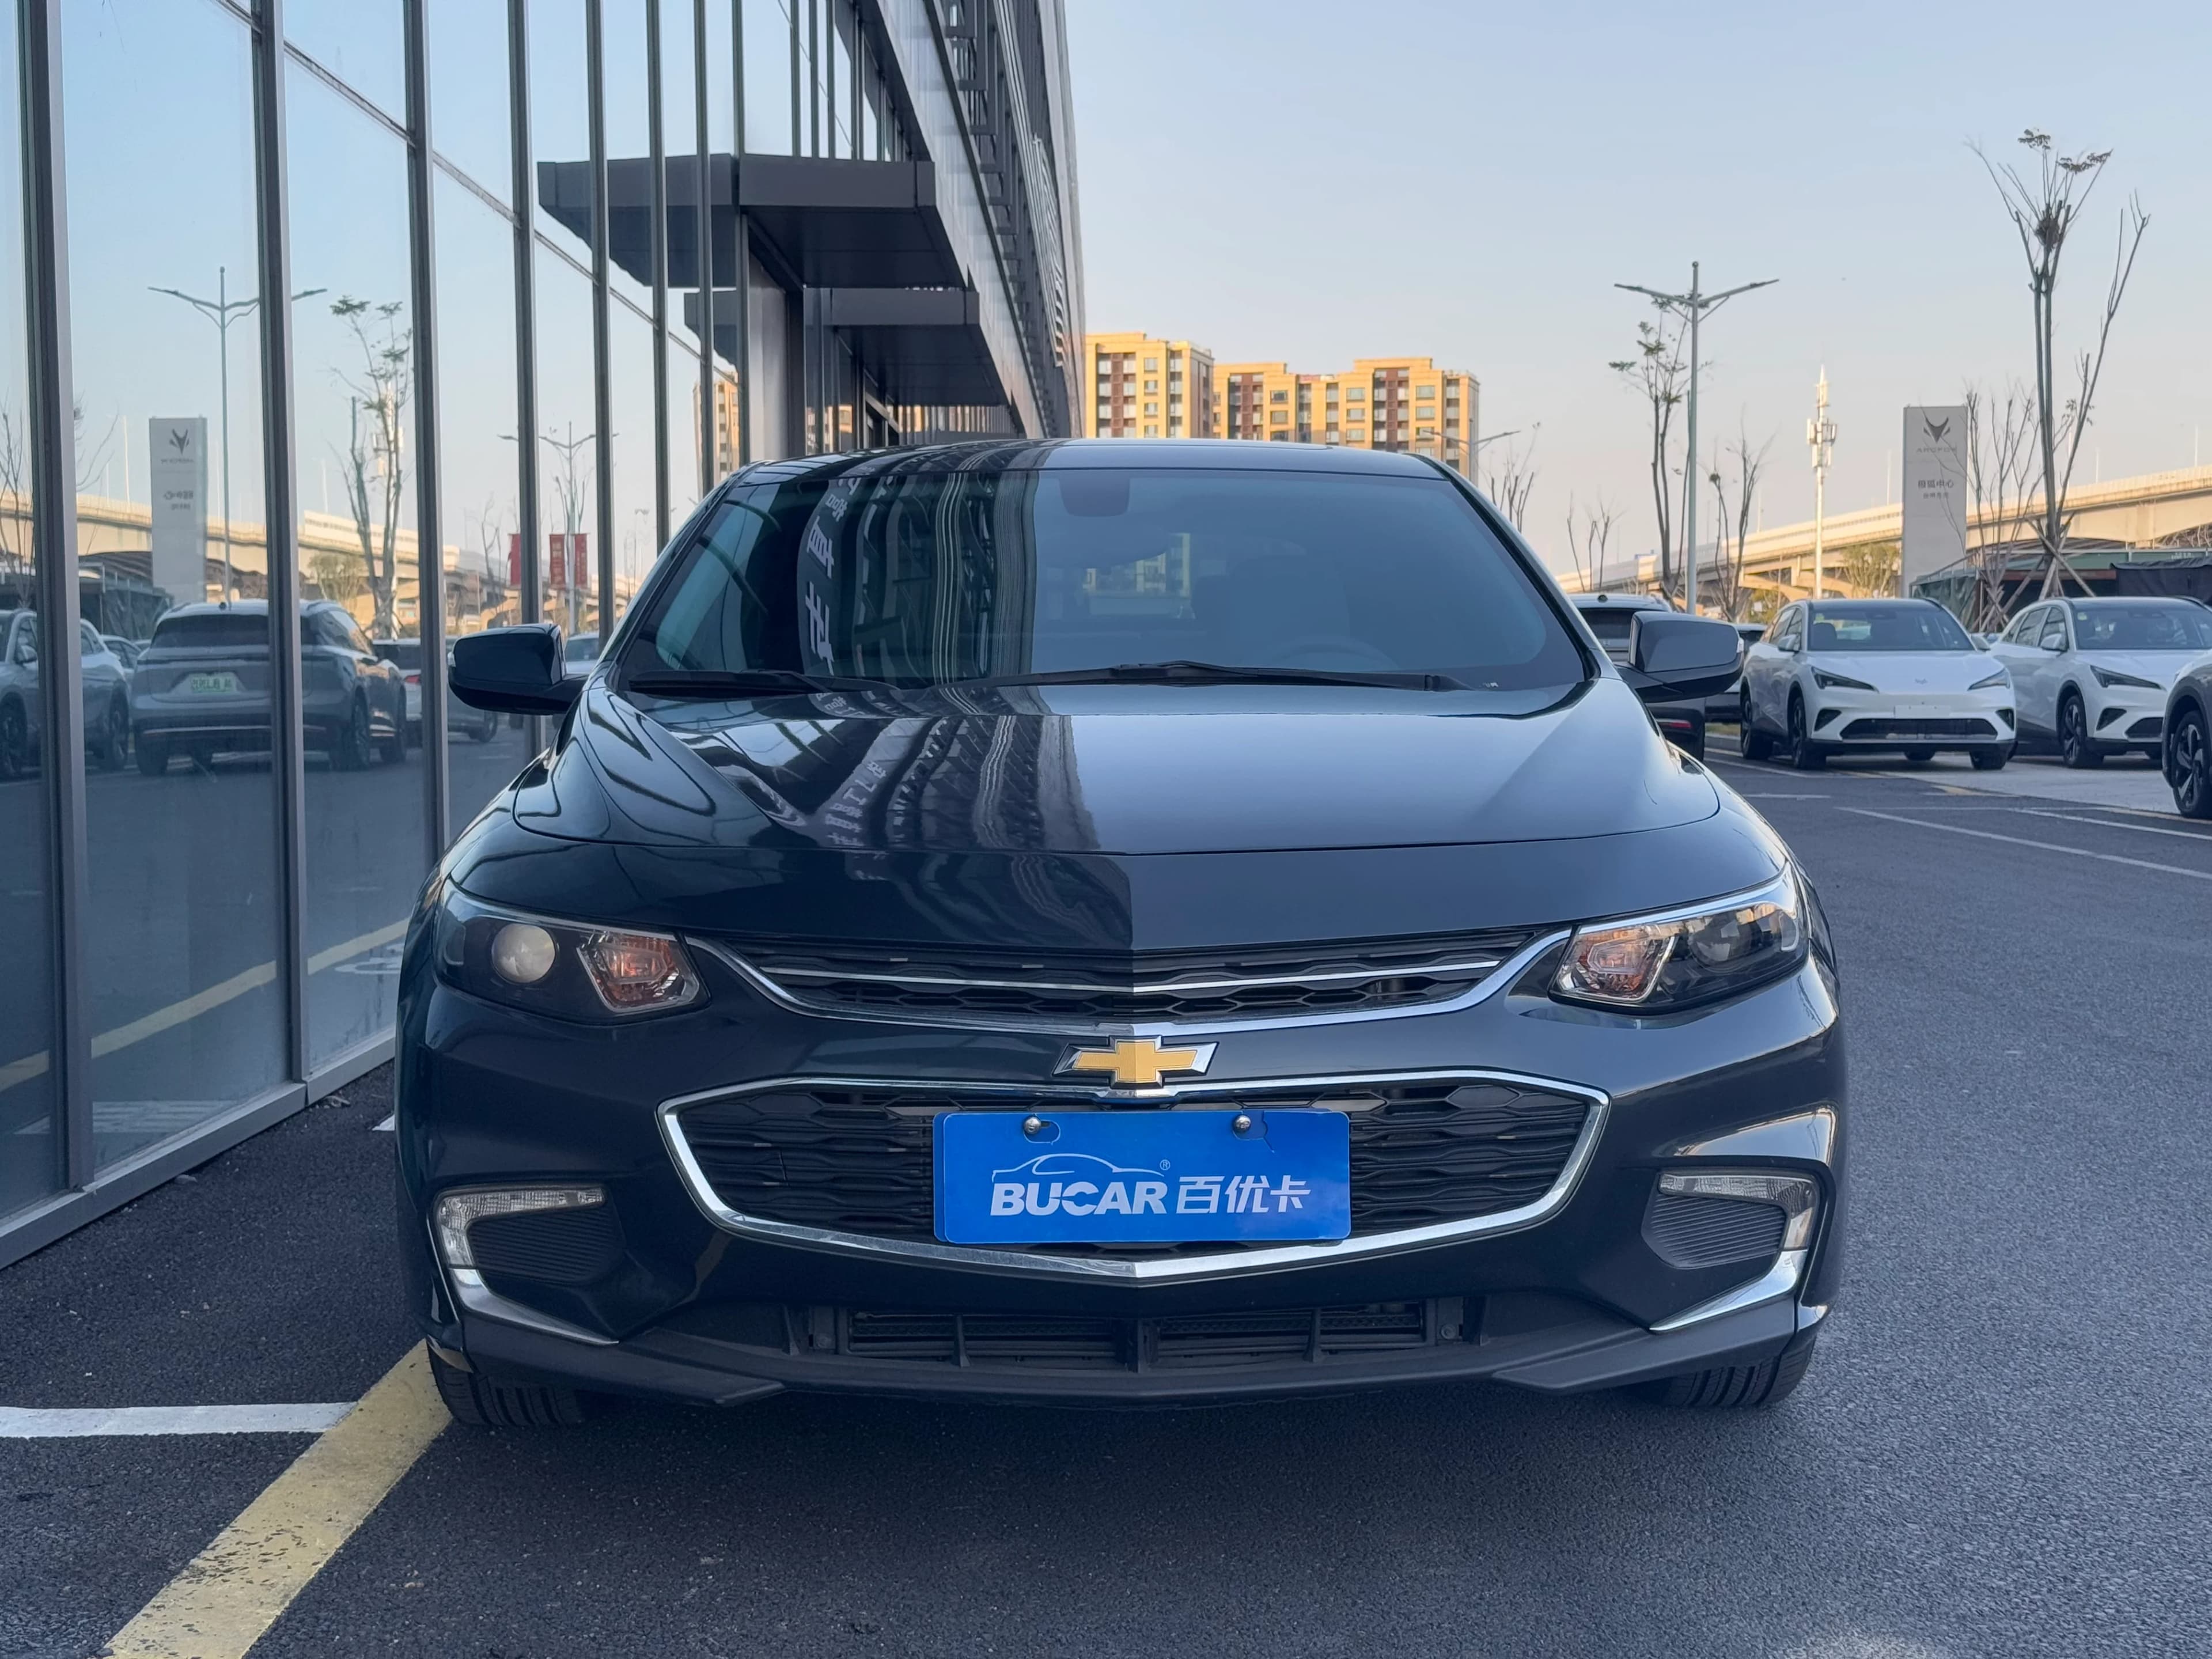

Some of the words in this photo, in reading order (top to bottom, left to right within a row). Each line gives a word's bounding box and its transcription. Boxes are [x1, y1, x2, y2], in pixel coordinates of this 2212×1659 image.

[990, 1181, 1168, 1216] BUCAR
[1176, 1175, 1311, 1214] 百优卡
